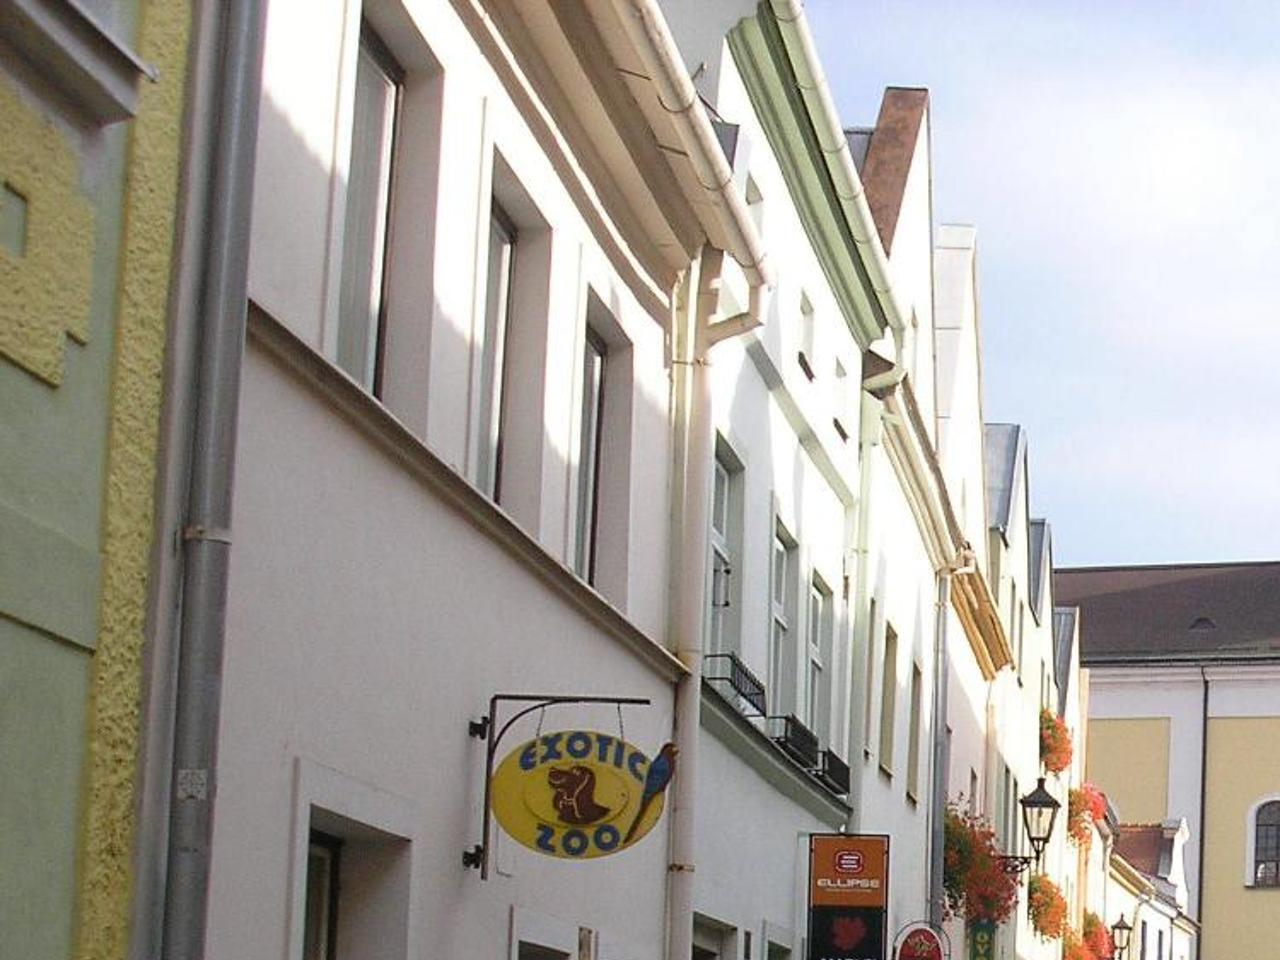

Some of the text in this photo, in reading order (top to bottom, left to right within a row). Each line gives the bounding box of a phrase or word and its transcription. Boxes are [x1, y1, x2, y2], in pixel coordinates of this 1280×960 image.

[519, 731, 651, 783] EXOTIC
[536, 822, 621, 856] ZOO
[816, 878, 880, 889] ELLIPSE
